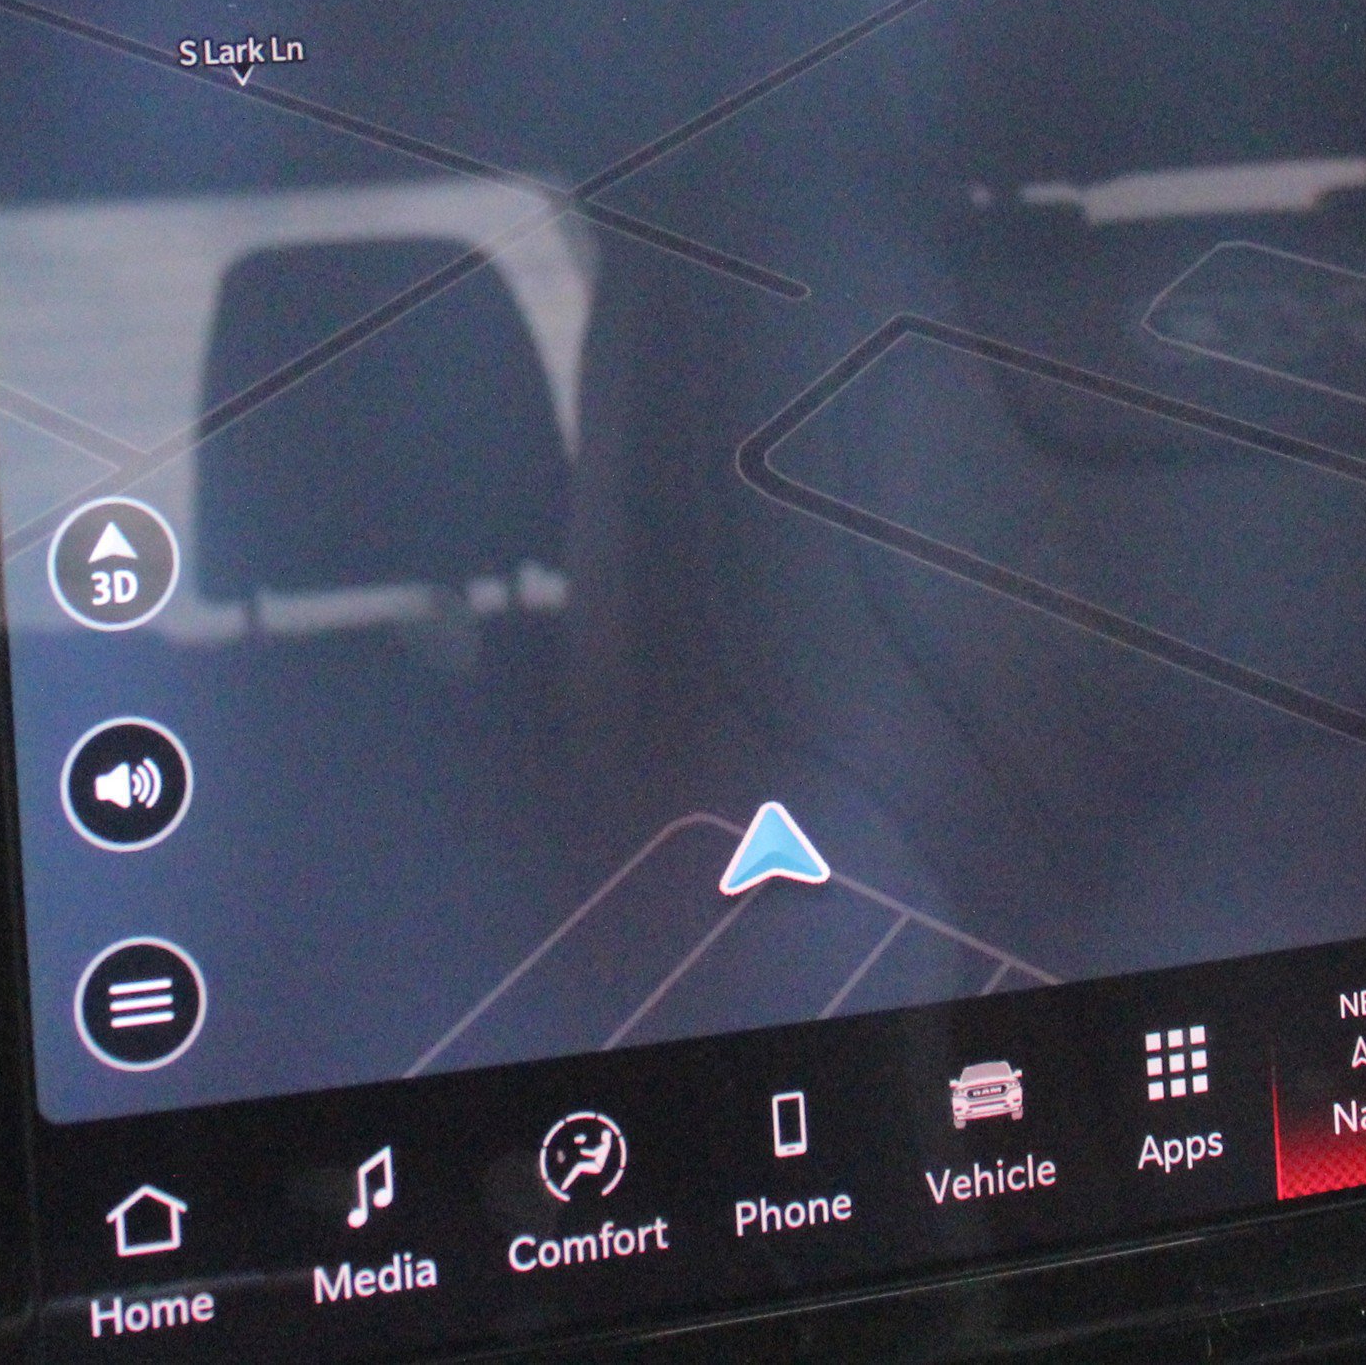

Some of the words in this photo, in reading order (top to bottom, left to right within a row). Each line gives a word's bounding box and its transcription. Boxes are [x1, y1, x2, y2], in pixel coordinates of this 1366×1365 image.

[179, 40, 197, 66] S
[204, 38, 264, 66] Lark
[270, 37, 303, 62] Ln
[91, 571, 138, 605] 3D
[1138, 1132, 1223, 1174] Apps
[926, 1154, 1057, 1205] Vehicle
[735, 1192, 853, 1237] Phone
[508, 1216, 669, 1273] Comfort
[313, 1253, 437, 1303] Media
[90, 1292, 215, 1336] Home
